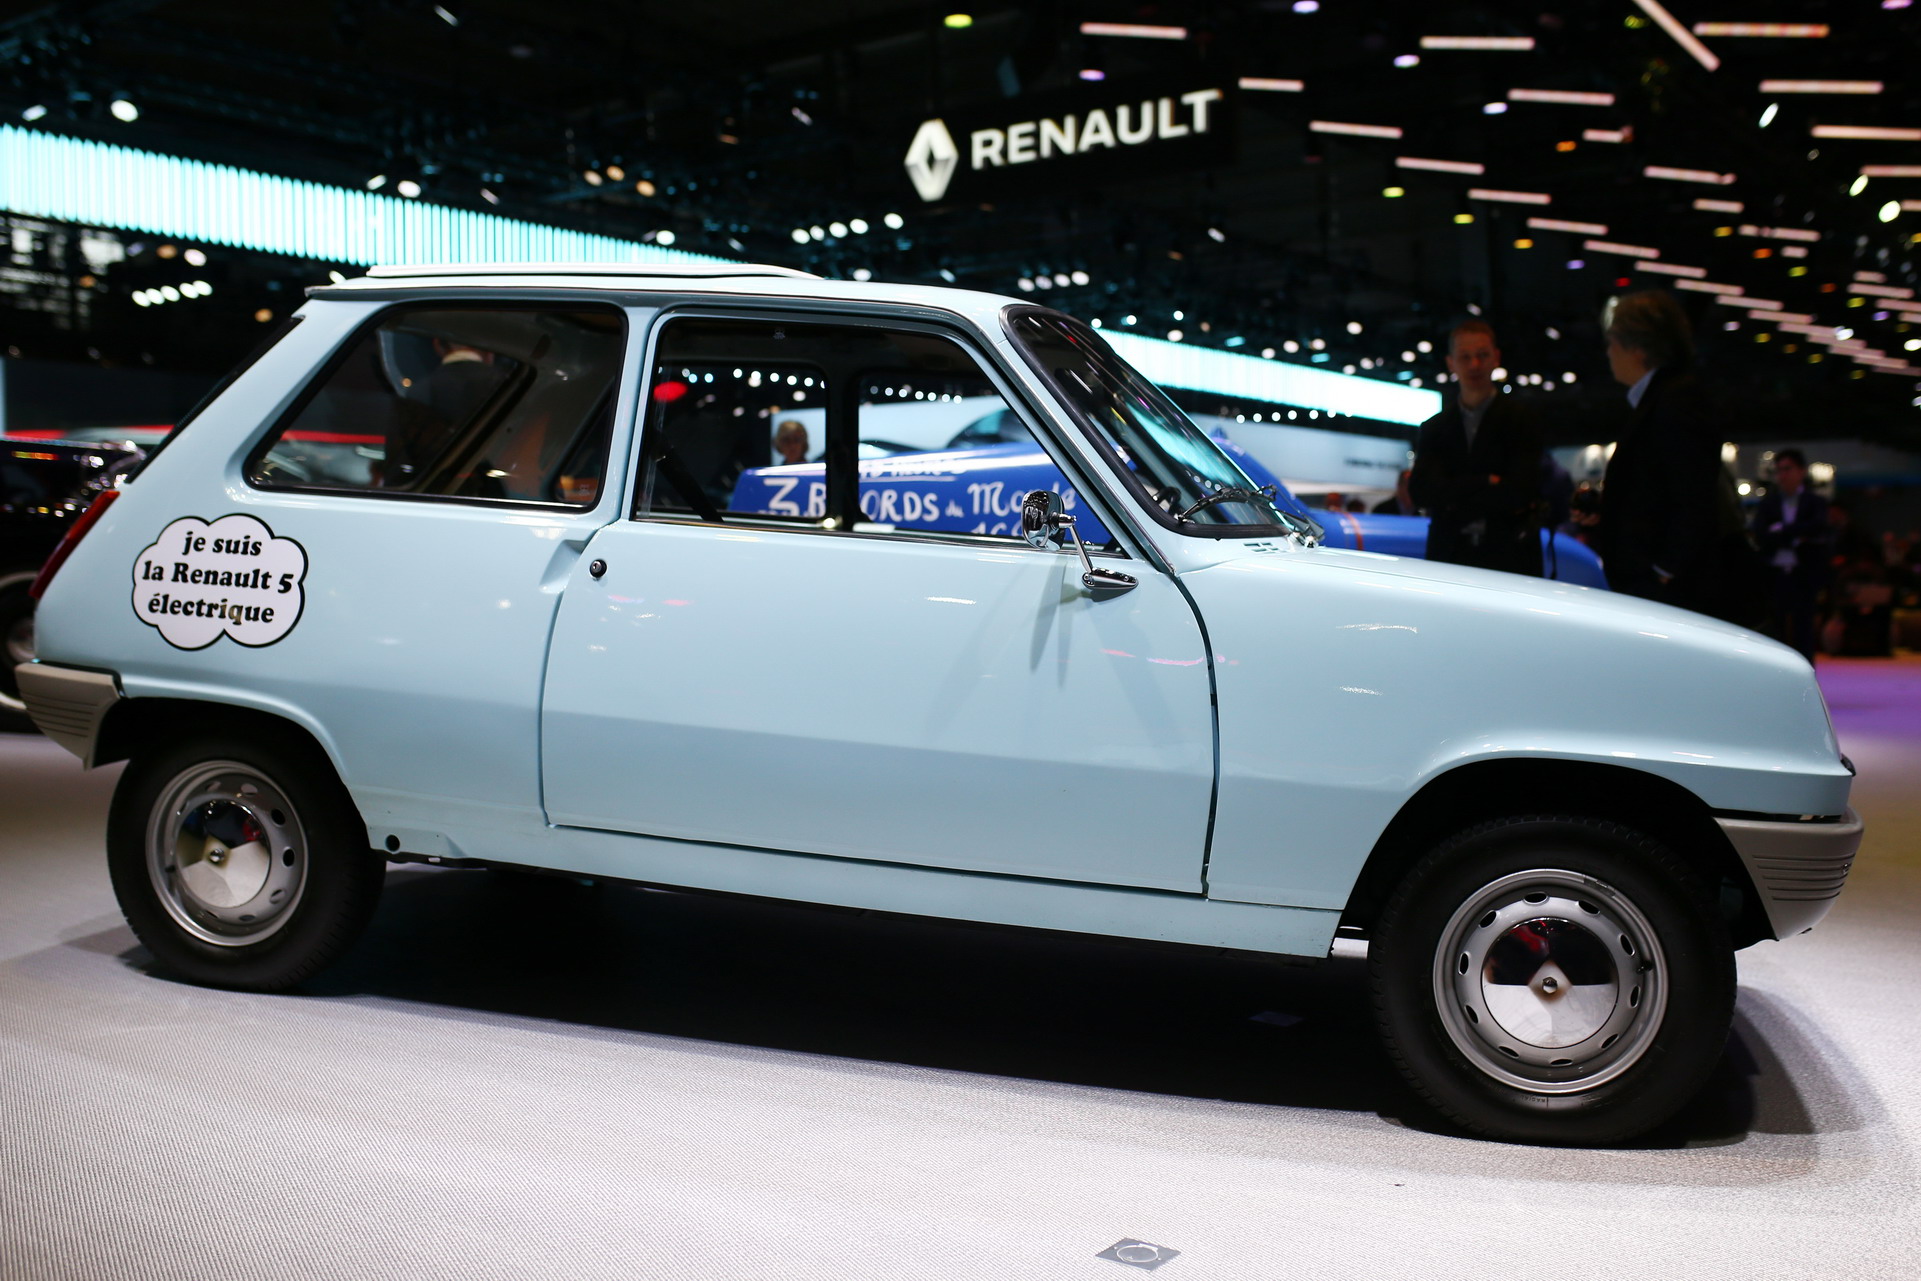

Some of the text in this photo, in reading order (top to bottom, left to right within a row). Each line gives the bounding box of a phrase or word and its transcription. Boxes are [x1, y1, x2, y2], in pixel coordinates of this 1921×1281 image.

[971, 88, 1223, 170] RENAULT
[807, 481, 940, 522] RORDS
[182, 531, 262, 556] je suis
[142, 560, 294, 594] la Renault 5
[148, 593, 275, 626] électrique
